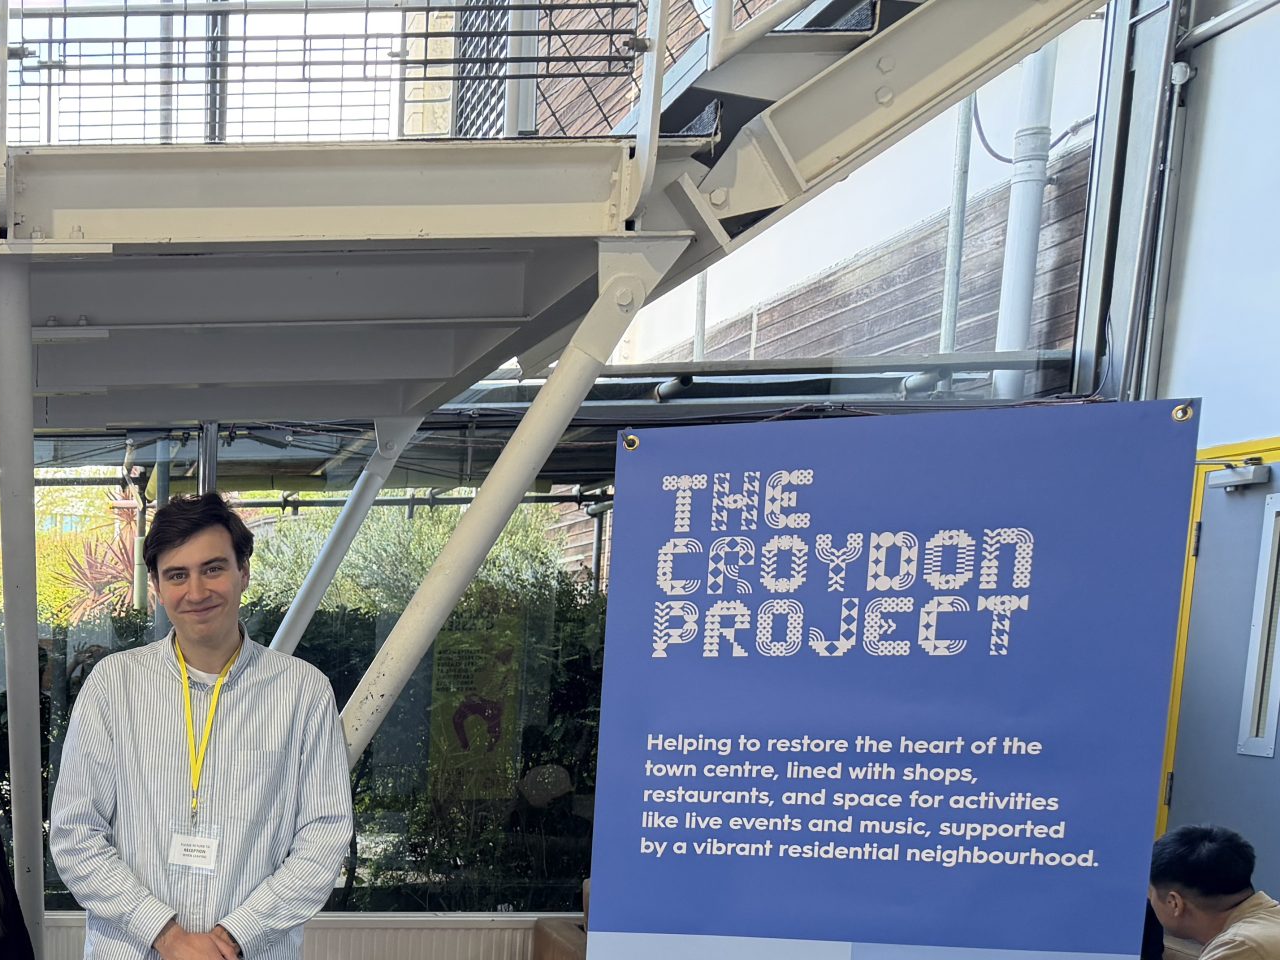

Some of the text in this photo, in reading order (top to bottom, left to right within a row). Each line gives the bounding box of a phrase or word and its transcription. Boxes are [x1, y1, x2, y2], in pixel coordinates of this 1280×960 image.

[663, 469, 813, 532] THE
[657, 527, 1034, 595] CROYDON
[652, 595, 1029, 657] PROJECT
[648, 734, 1042, 755] Helping to restore the heart of the
[645, 760, 977, 785] town centre, lined with shops,
[644, 786, 1058, 810] restaurants, and space for activities
[642, 812, 1065, 840] like live events and music, supported
[641, 837, 1098, 867] by a vibrant residential neighbourhood.
